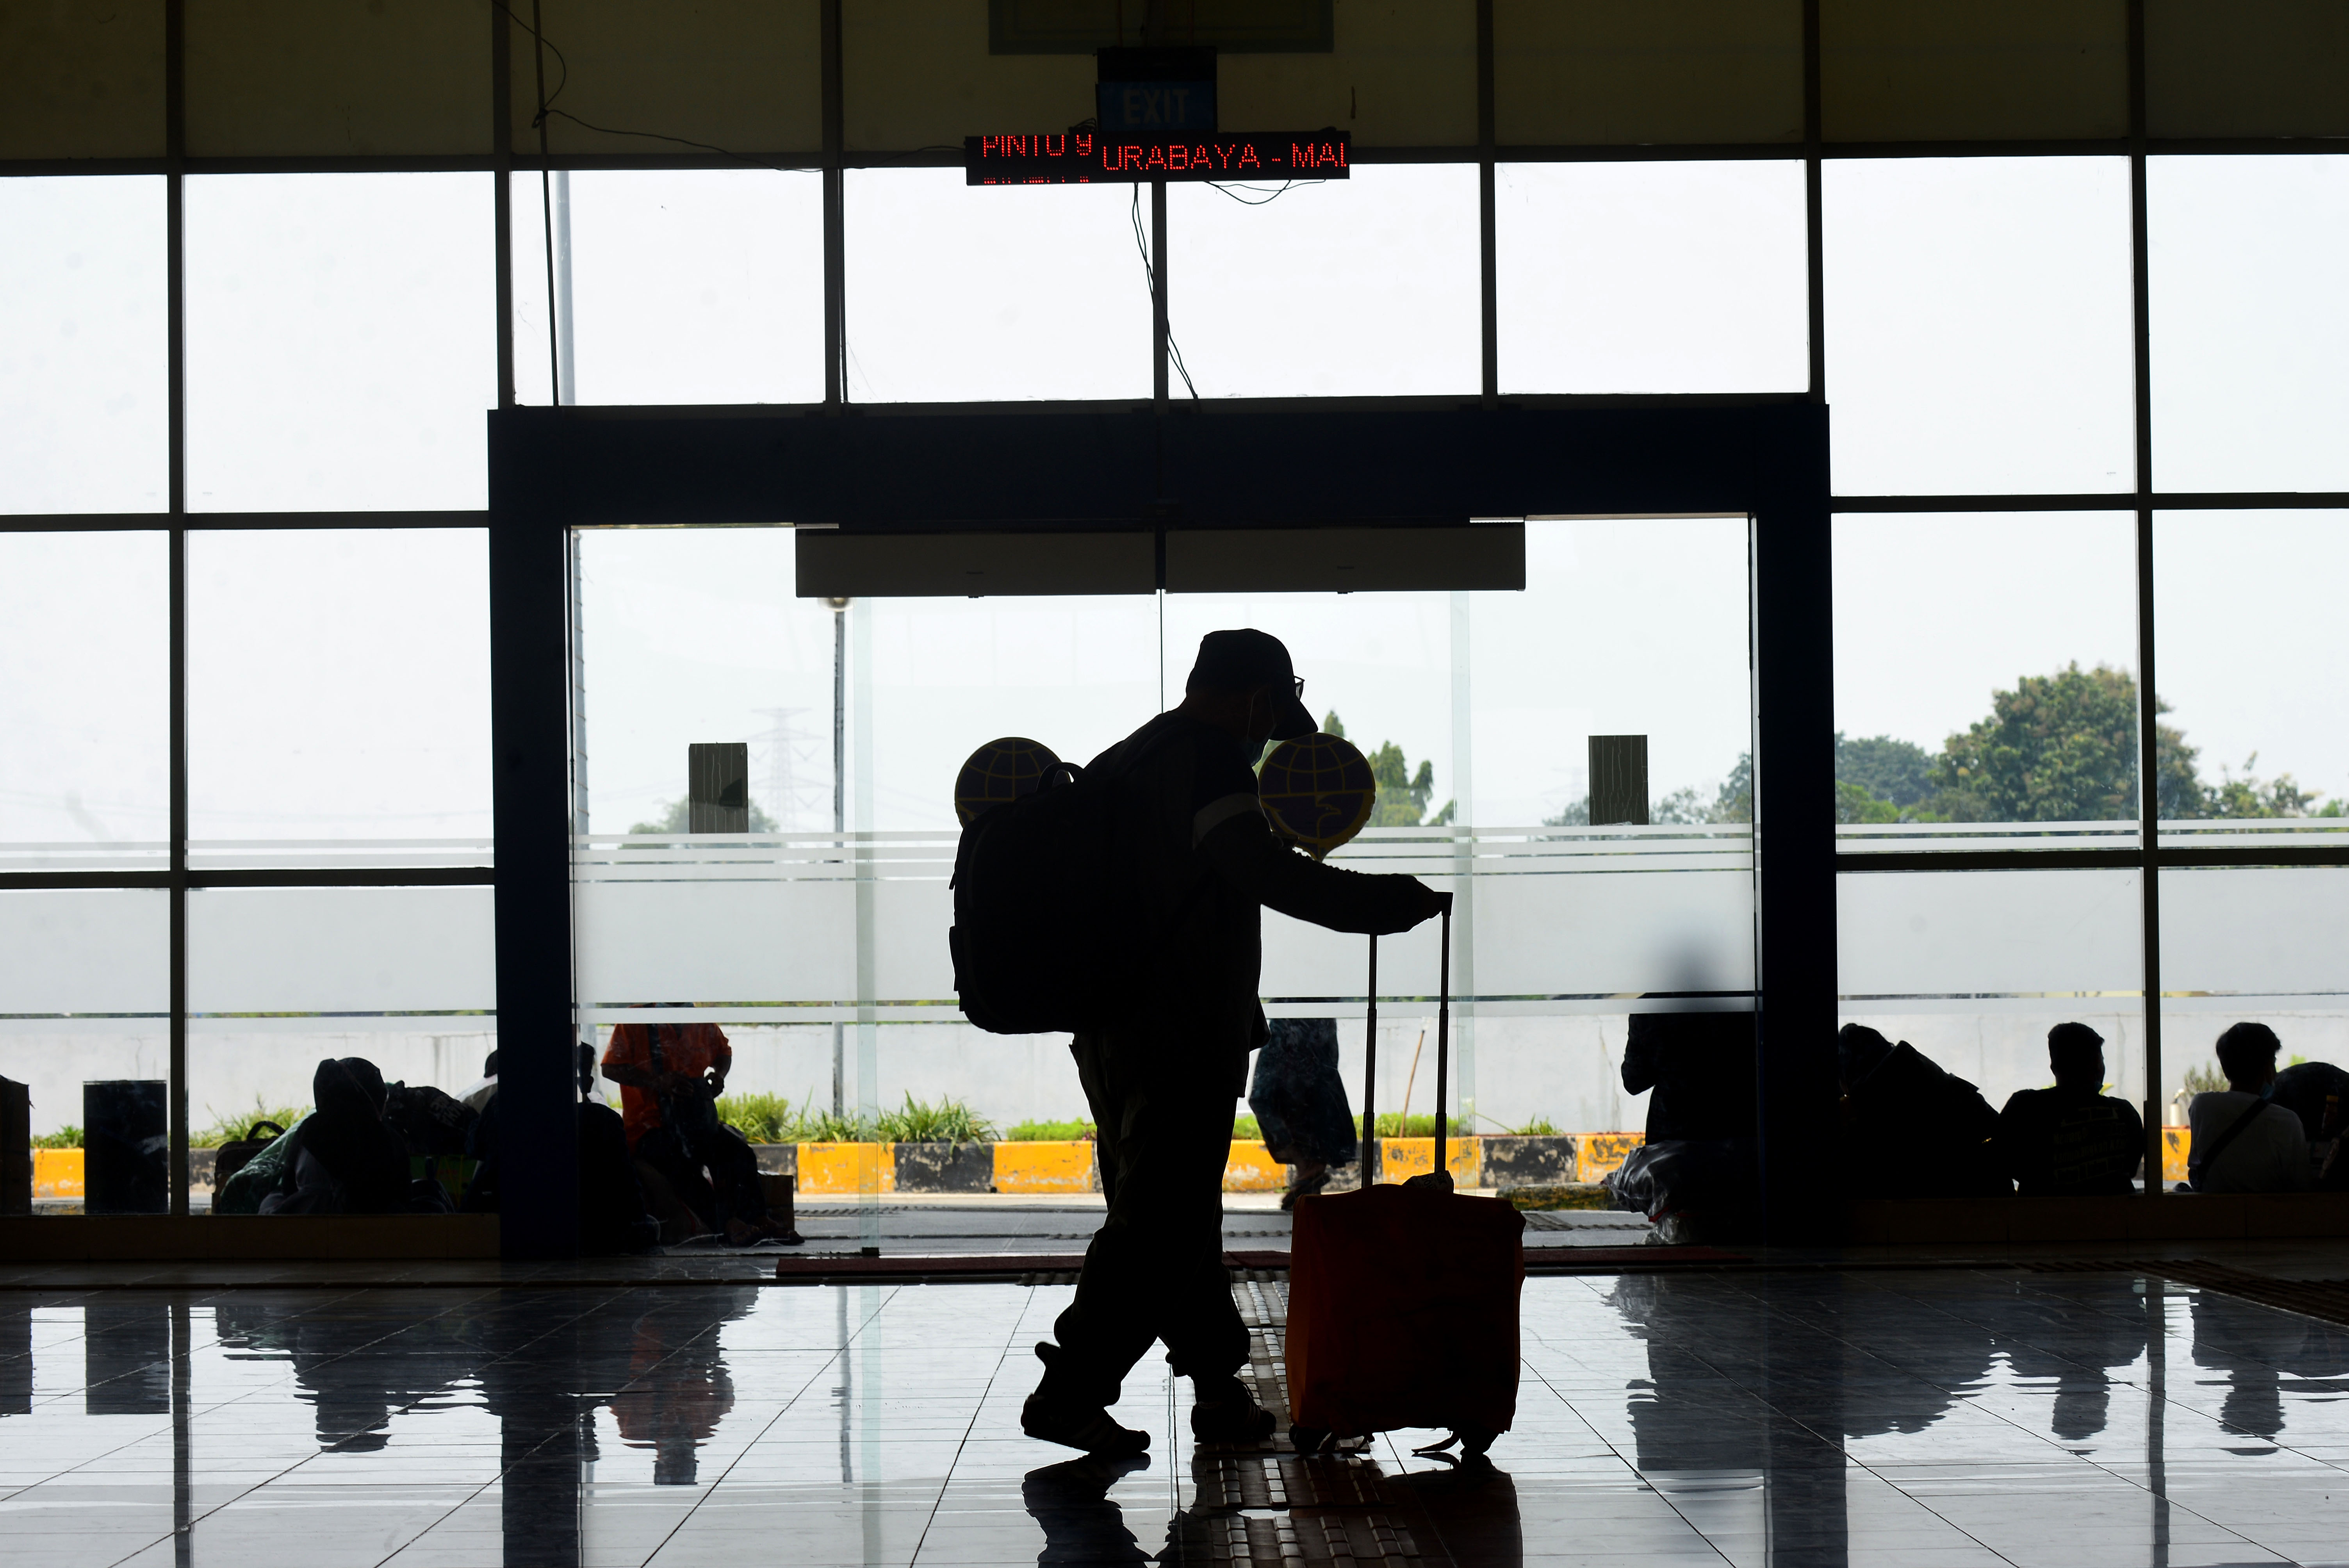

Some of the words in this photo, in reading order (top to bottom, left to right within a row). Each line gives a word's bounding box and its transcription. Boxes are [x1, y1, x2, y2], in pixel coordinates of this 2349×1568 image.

[1123, 88, 1190, 124] EXIT
[1103, 144, 1260, 171] URABAYA
[1435, 1171, 1447, 1185] CGK
